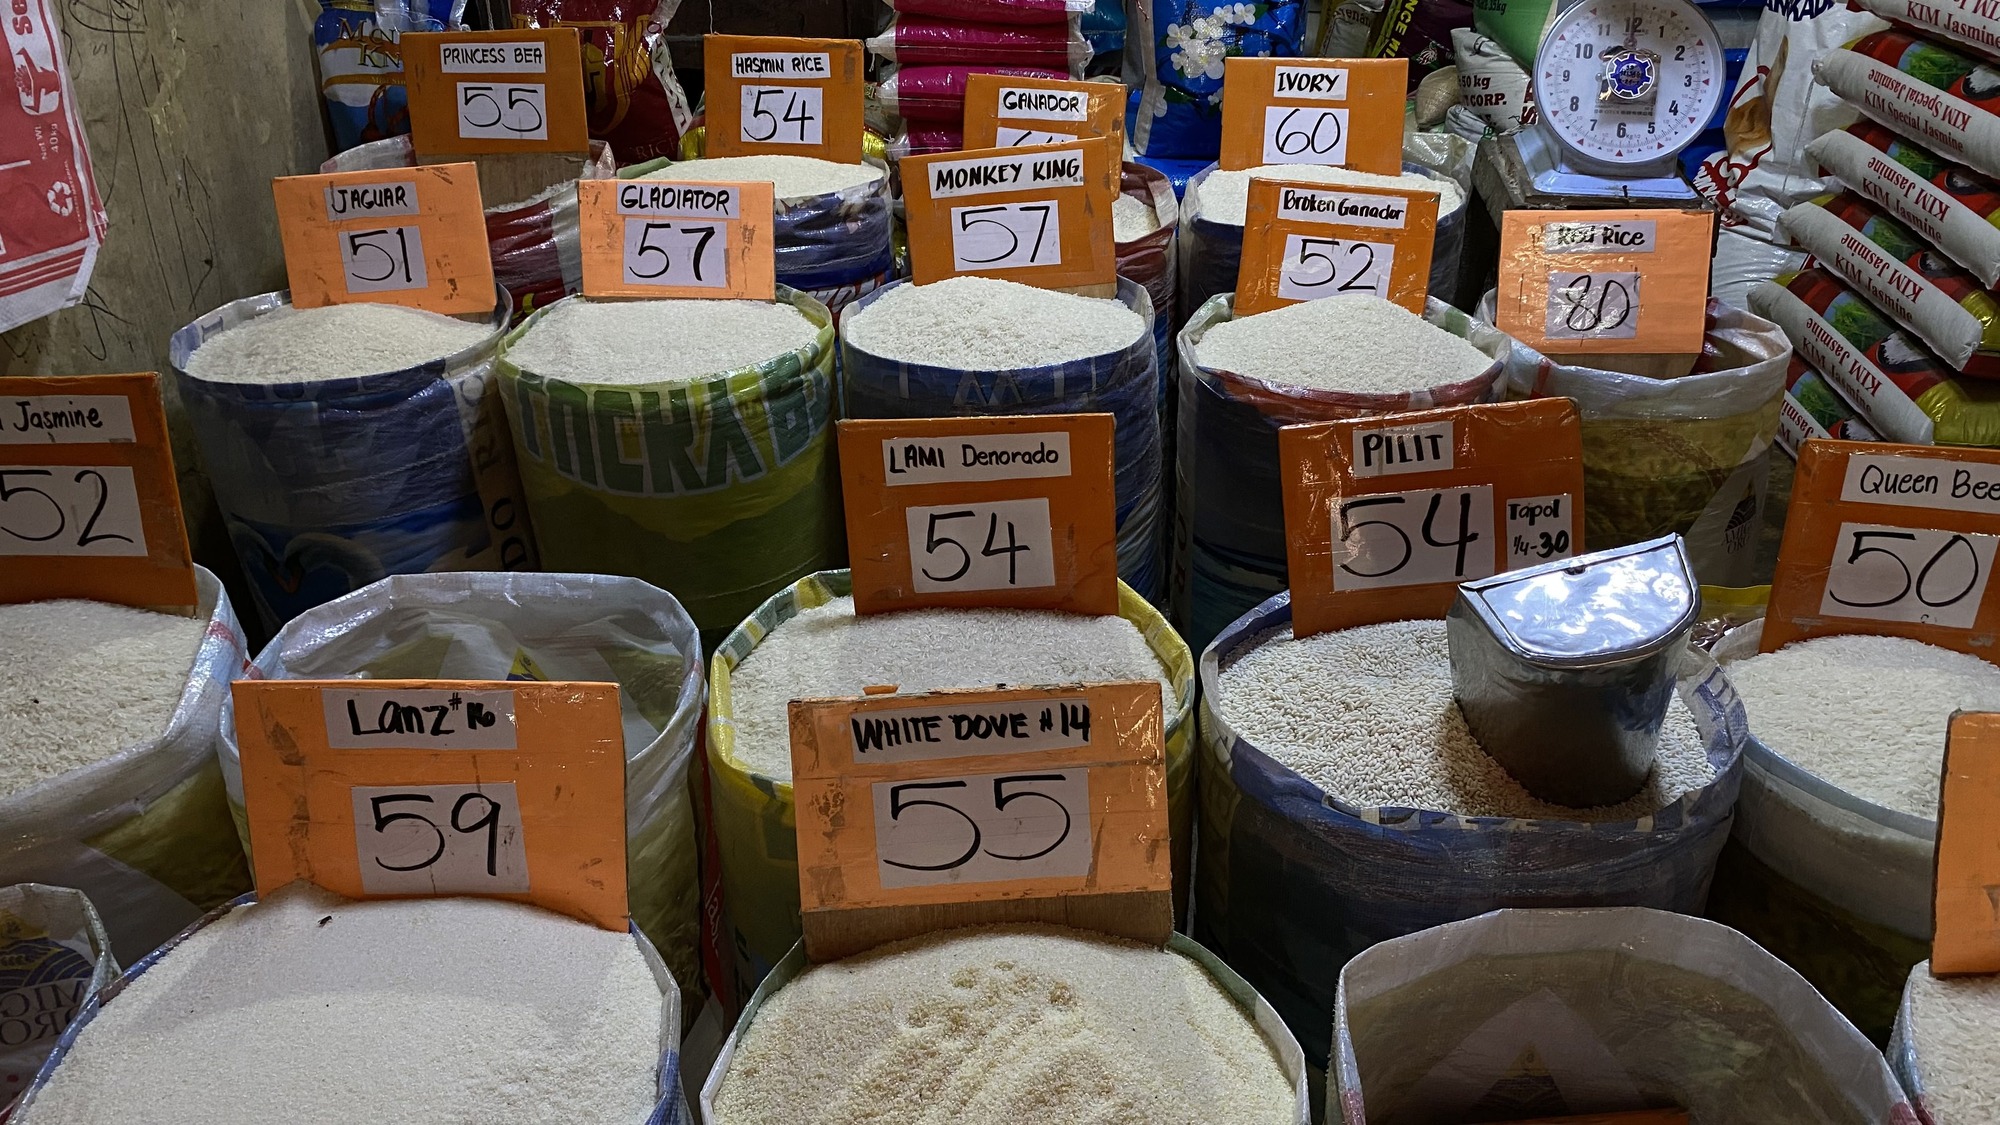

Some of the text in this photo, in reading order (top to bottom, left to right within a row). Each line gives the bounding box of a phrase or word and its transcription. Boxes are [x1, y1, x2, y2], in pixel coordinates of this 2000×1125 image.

[1598, 23, 1611, 36] 11
[1625, 17, 1642, 33] 12
[1907, 1, 1940, 26] KIM
[1659, 26, 1665, 38] 1
[443, 48, 543, 65] PRINCESS BEA
[735, 57, 824, 74] HASMIN RICE
[1575, 43, 1594, 59] 10
[1674, 45, 1686, 61] 2
[1277, 72, 1339, 93] IVORY
[1473, 75, 1491, 90] kg
[1563, 70, 1570, 82] 9
[1684, 75, 1692, 87] 3
[463, 86, 543, 132] 55
[743, 89, 815, 142] 54
[1002, 91, 1079, 113] GANADOR
[1570, 96, 1580, 111] 8
[1669, 100, 1679, 116] 4
[1868, 69, 1972, 132] KIM Special Jasmine
[1275, 108, 1341, 156] 60
[1590, 119, 1598, 131] 7
[1617, 122, 1626, 138] 6
[1648, 122, 1655, 134] 5
[1864, 89, 1964, 152] KIM Special Jasmine
[935, 158, 1080, 191] MONKEY KING
[1867, 157, 1951, 223] KIM Jasmine
[331, 184, 408, 213] JAGUAR
[620, 184, 730, 215] GLADIATOR
[1283, 189, 1405, 222] Broken Ganador
[960, 205, 1051, 263] 57
[1602, 224, 1645, 246] Rice
[350, 228, 413, 282] 51
[628, 223, 716, 282] 57
[1288, 238, 1377, 292] 52
[1841, 233, 1924, 304] KIM Jasmine
[1566, 274, 1630, 332] 80
[1834, 252, 1913, 324] KIM Jasmine
[1806, 318, 1882, 397] KIM Jasmine
[13, 400, 104, 432] Jasmine
[1781, 400, 1815, 441] Jasmi
[889, 442, 1059, 474] LAMI Denorado
[1362, 434, 1444, 467] PILIT
[1860, 464, 2000, 500] Queen Bee
[0, 469, 134, 547] 52
[1508, 499, 1560, 526] Tapol
[921, 511, 1031, 584] 54
[1338, 493, 1479, 578] 54
[1829, 530, 1979, 608] 50
[851, 716, 942, 753] WHITE
[949, 713, 1030, 742] DOVE
[370, 792, 501, 876] 59
[882, 774, 1072, 872] 55
